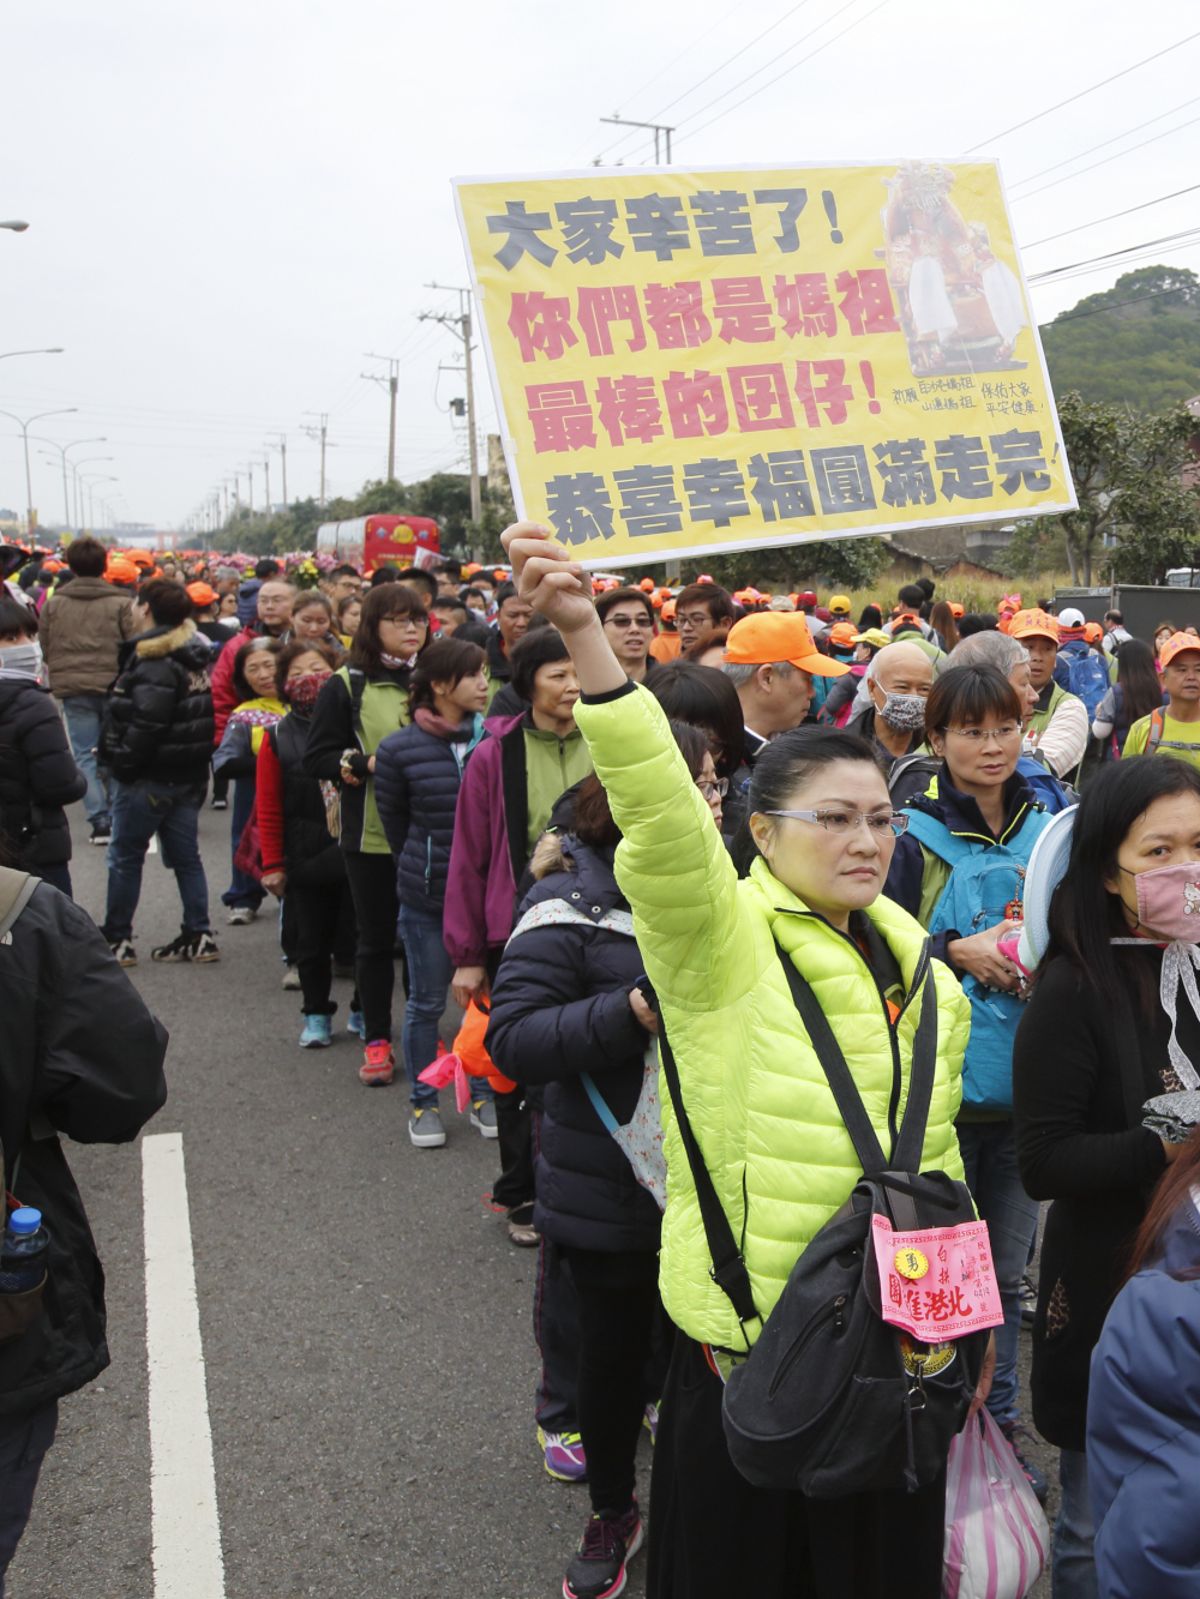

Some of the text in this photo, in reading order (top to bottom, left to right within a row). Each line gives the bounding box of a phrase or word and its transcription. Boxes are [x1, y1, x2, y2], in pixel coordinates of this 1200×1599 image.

[486, 188, 845, 272] 大家辛苦了!
[508, 268, 901, 363] 你們都是媽祖
[545, 428, 1062, 546] 恭喜幸福圓滿走完!
